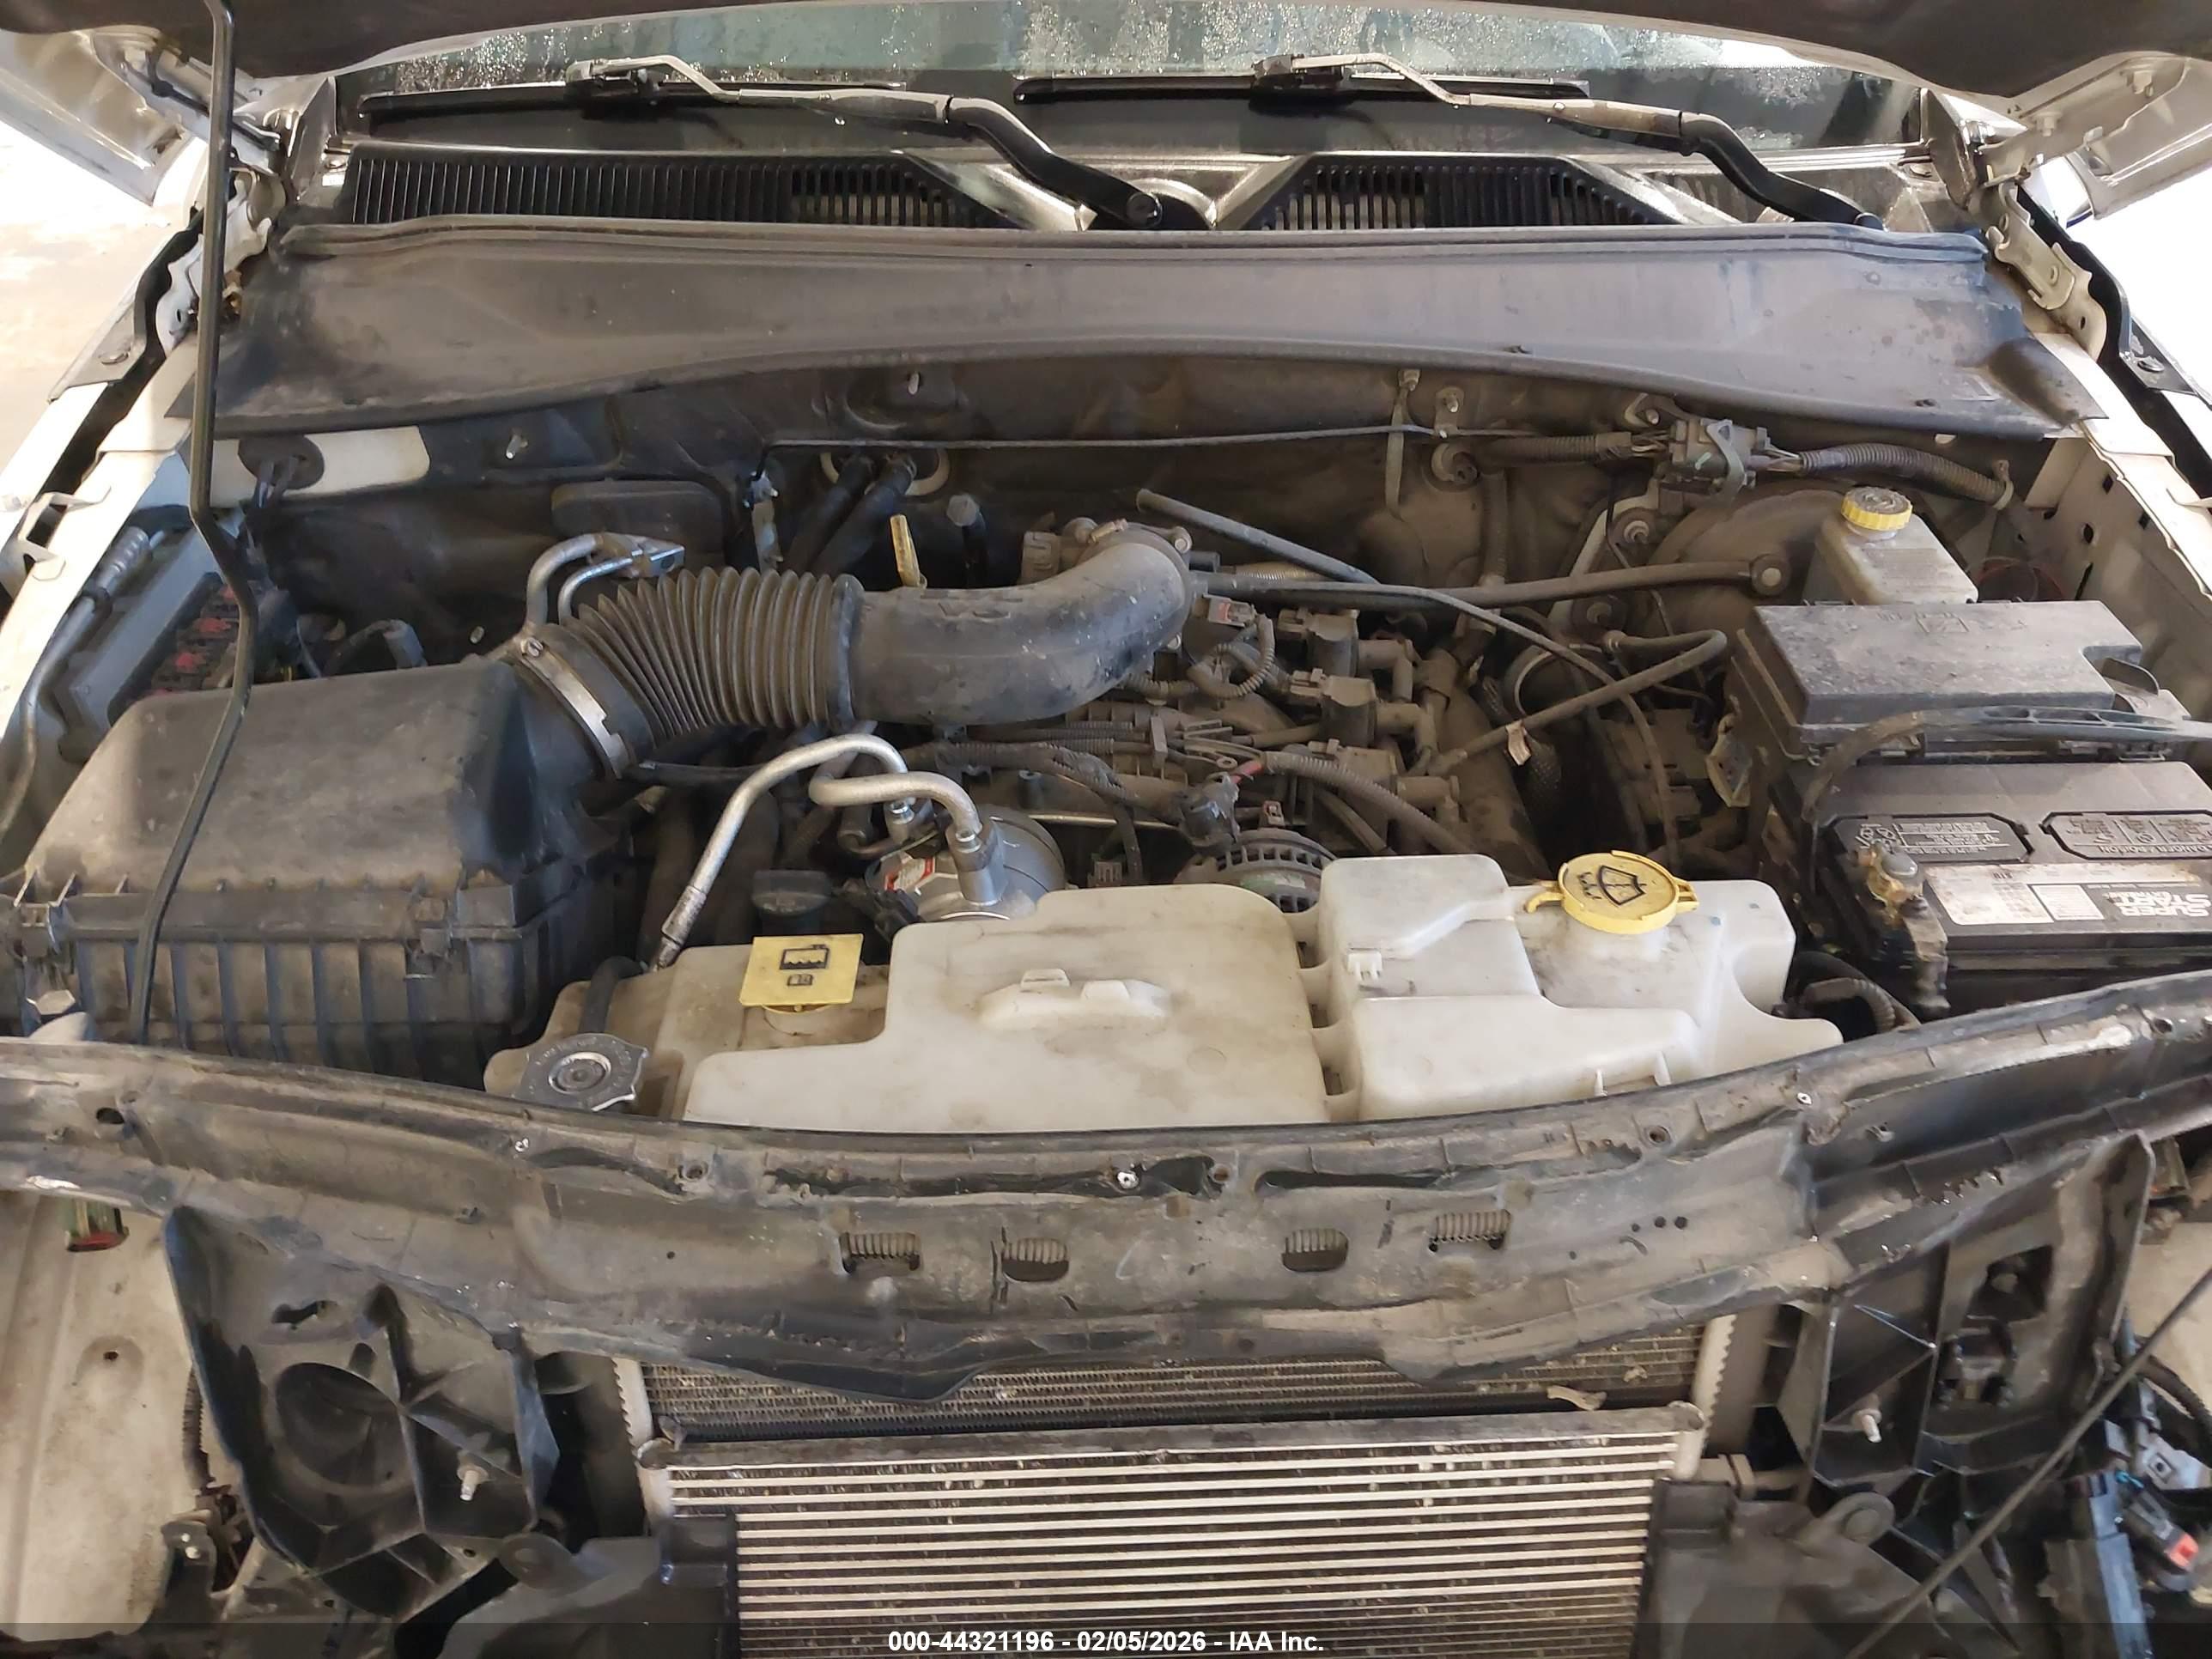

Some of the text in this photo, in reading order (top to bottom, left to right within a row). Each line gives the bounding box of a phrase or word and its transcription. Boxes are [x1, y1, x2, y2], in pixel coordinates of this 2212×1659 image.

[2100, 844, 2148, 854] POISON
[2112, 893, 2211, 907] START
[2120, 905, 2210, 916] SUPER
